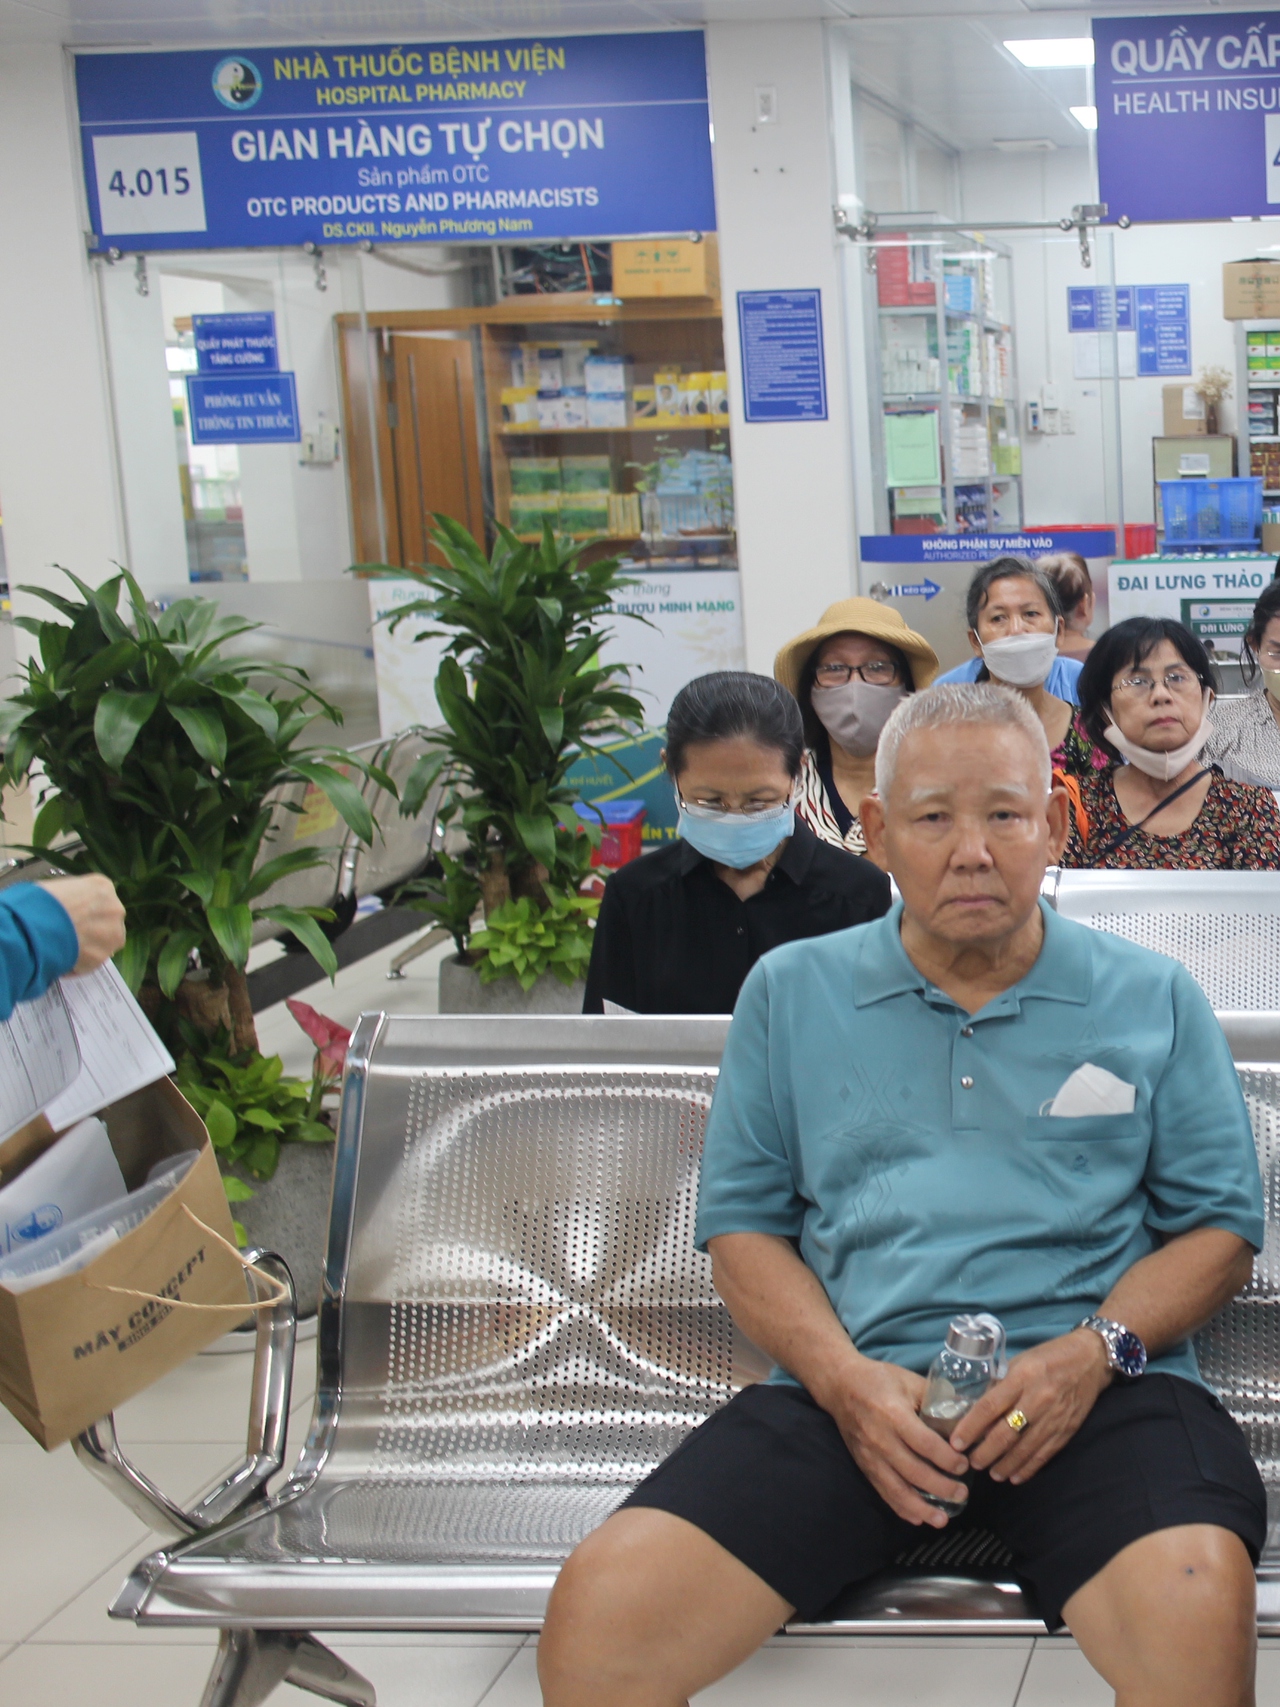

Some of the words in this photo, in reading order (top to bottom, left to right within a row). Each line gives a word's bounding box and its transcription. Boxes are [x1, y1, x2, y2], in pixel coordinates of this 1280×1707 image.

[273, 52, 330, 81] NHÀ
[333, 46, 423, 78] THUỐC
[429, 46, 500, 79] BỆNH
[504, 43, 566, 76] VIỆN
[1110, 25, 1211, 76] QUẦY
[316, 84, 412, 106] HOSPITAL
[416, 80, 527, 102] PHARMACY
[1113, 90, 1210, 115] HEALTH
[231, 128, 319, 162] GIAN
[327, 119, 432, 158] HÀNG
[438, 117, 492, 161] TỰ
[498, 118, 605, 158] CHỌN
[108, 167, 191, 198] 4.015
[357, 167, 393, 187] Sản
[397, 164, 449, 188] phẩm
[452, 165, 490, 184] OTC
[246, 198, 288, 217] OTC
[291, 193, 400, 216] PRODUCTS
[405, 192, 448, 212] AND
[453, 187, 599, 211] PHARMACISTS
[381, 218, 437, 238] Nguyễn
[439, 218, 497, 235] Phương
[499, 218, 533, 232] Nam
[922, 536, 958, 550] KHÔNG
[1031, 535, 1053, 549] VÀO
[923, 550, 977, 561] AUTHORIZED
[1118, 576, 1148, 591] ĐAI
[1155, 575, 1206, 590] LƯNG
[1212, 568, 1263, 588] THẢO
[659, 601, 692, 613] MINH
[696, 600, 735, 616] MẠNG
[1200, 623, 1217, 634] ĐAI
[128, 1246, 206, 1330] CONCEPT
